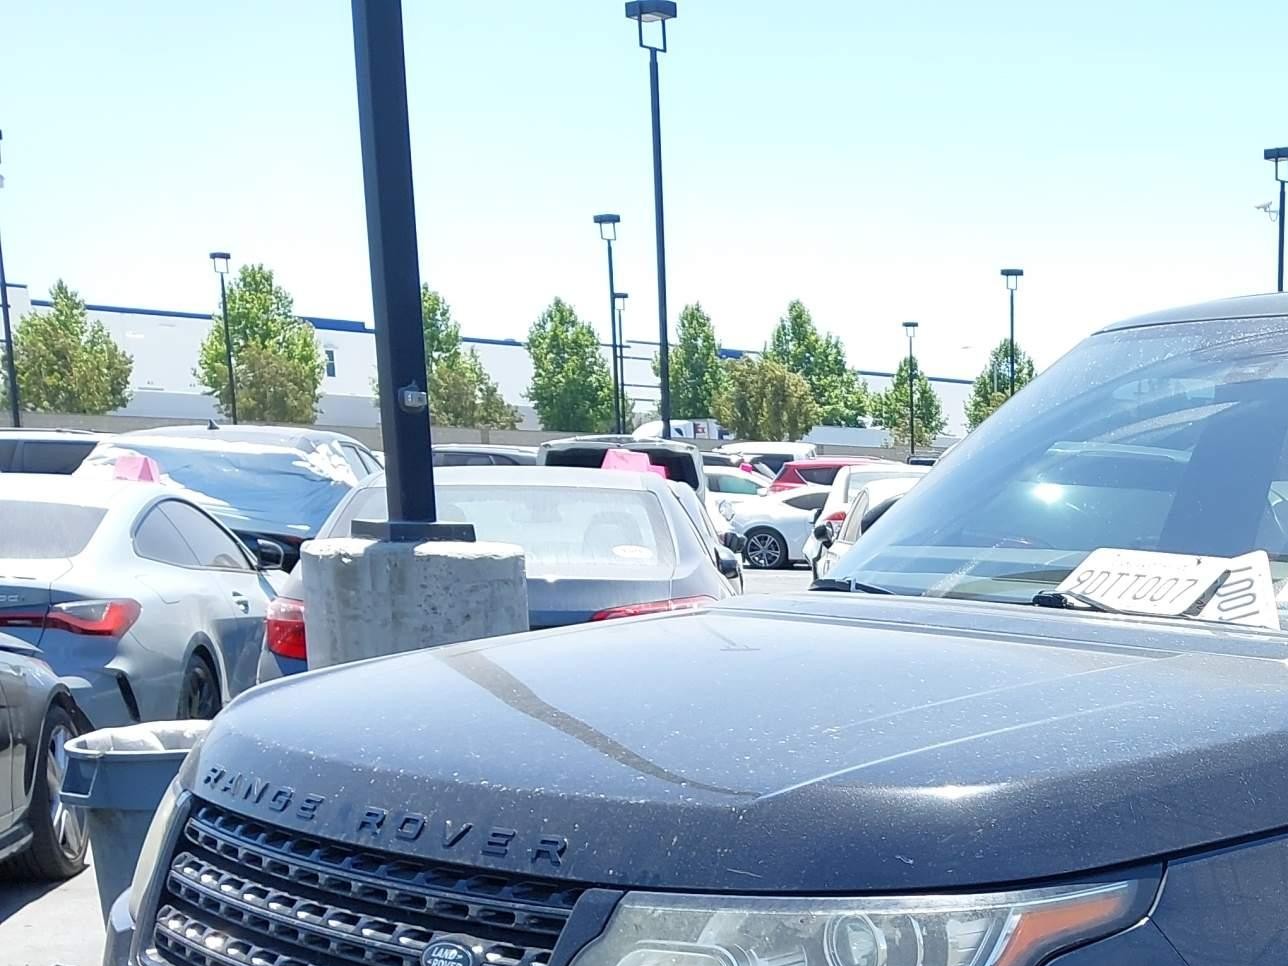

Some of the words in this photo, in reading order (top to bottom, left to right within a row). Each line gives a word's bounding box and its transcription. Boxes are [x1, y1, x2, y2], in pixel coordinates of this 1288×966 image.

[204, 764, 323, 821] RANGE
[357, 806, 569, 866] ROVER
[432, 947, 458, 960] LAND
